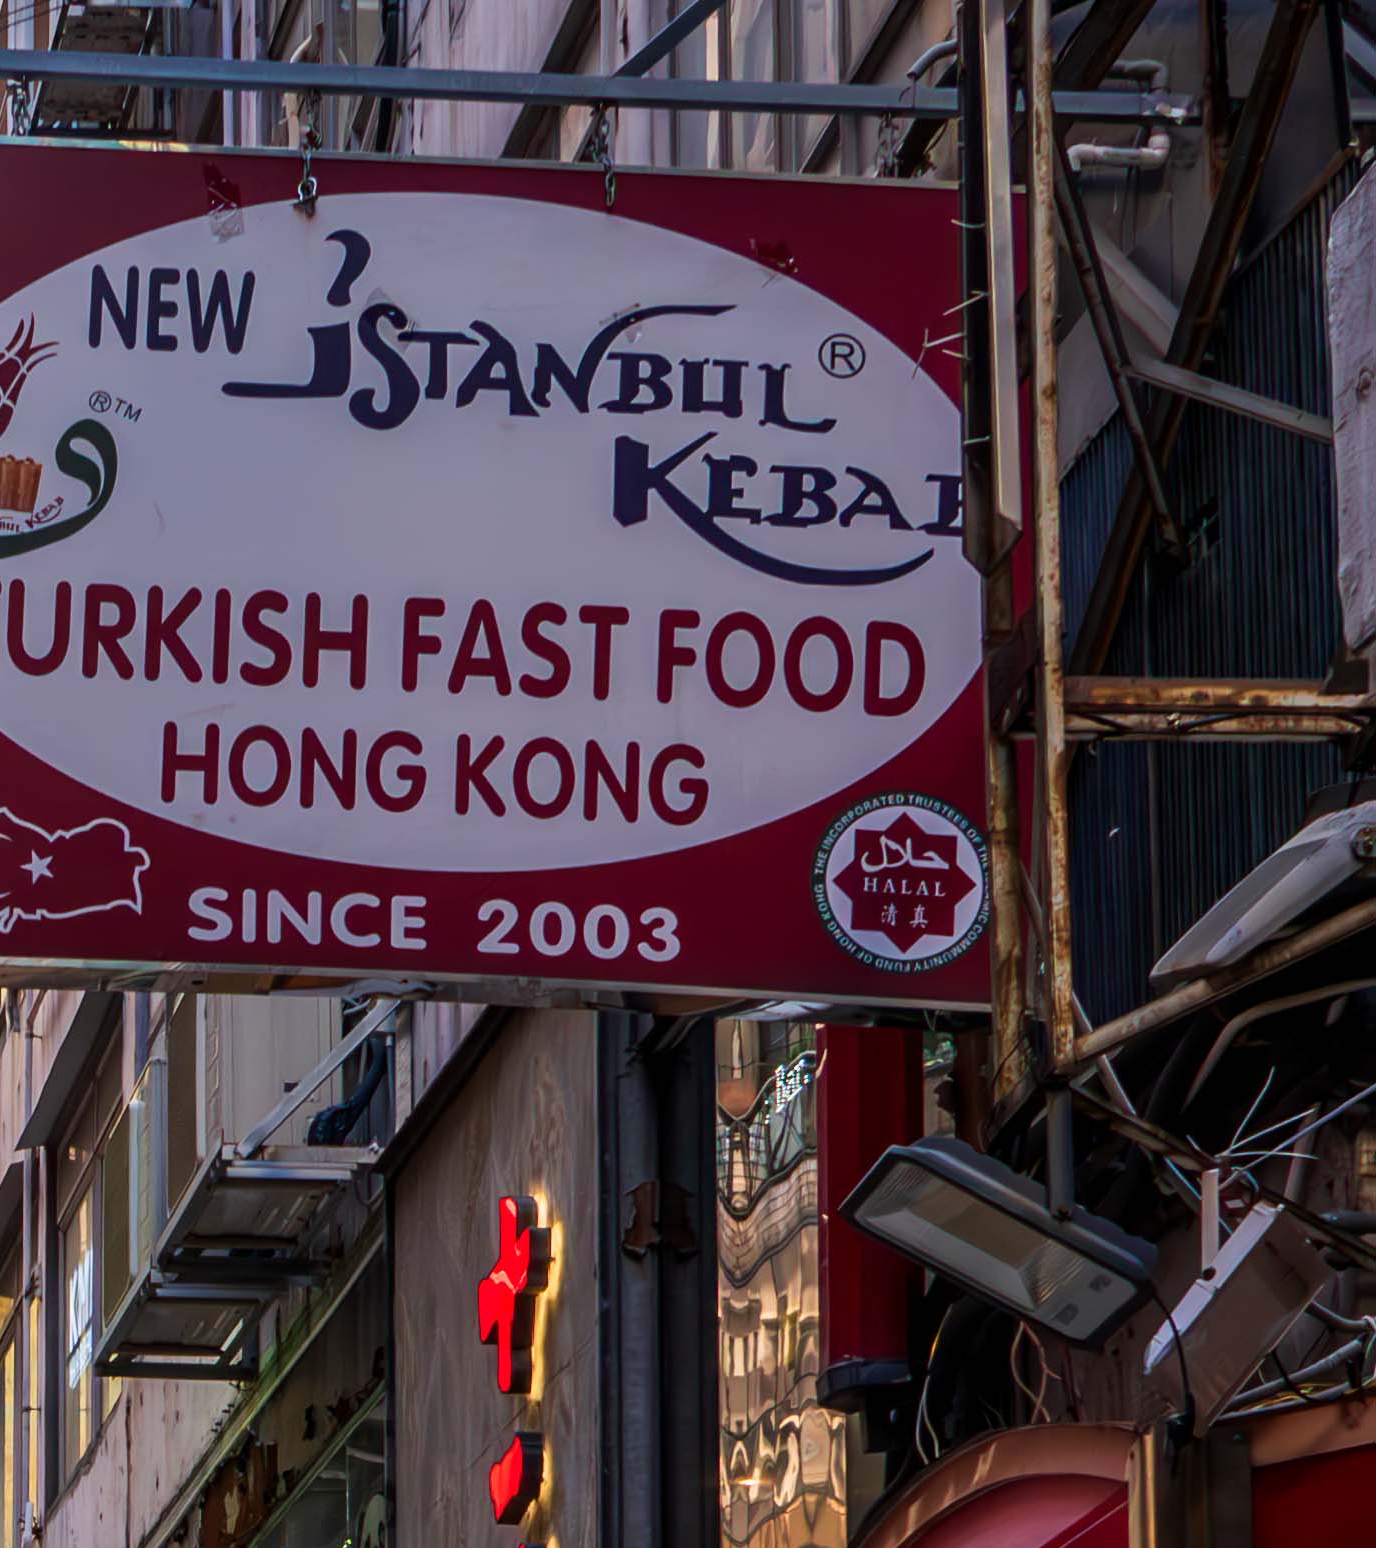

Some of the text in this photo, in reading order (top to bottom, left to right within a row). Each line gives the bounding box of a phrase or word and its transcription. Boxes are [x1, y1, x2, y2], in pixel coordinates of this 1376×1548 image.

[88, 264, 256, 356] NEW
[401, 596, 630, 702] FAST
[655, 609, 926, 718] FOOD
[160, 722, 710, 826] HONG KONG
[823, 793, 904, 851] INCORPORATED
[908, 794, 969, 832] TRUSTEES
[861, 834, 950, 873] حلال
[863, 876, 946, 897] HALAL
[881, 901, 928, 928] 清真
[186, 886, 681, 964] SINCE 2003
